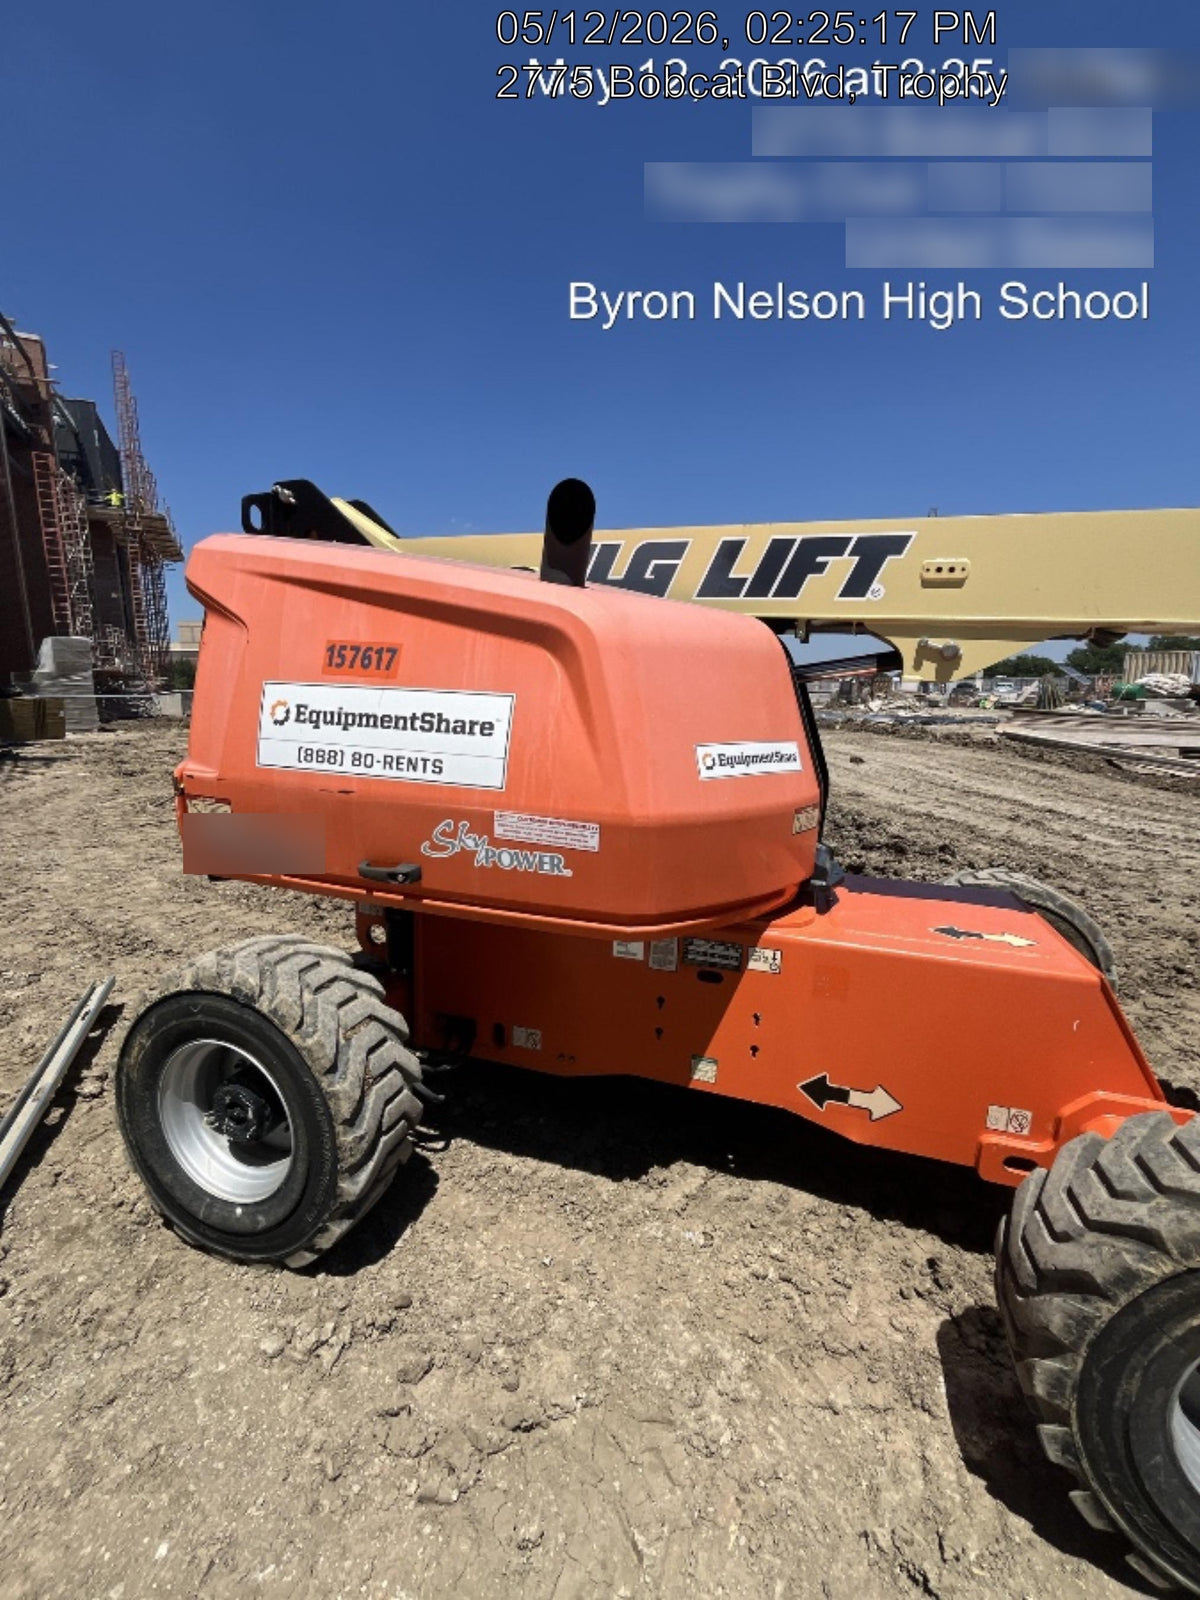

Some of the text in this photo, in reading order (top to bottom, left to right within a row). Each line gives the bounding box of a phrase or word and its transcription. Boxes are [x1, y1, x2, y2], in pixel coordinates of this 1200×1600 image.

[585, 531, 918, 601] LG LIFT
[325, 643, 398, 672] 157617
[294, 703, 496, 737] EquipmentShare
[351, 753, 444, 775] 80-RENTS
[483, 847, 567, 876] POWER
